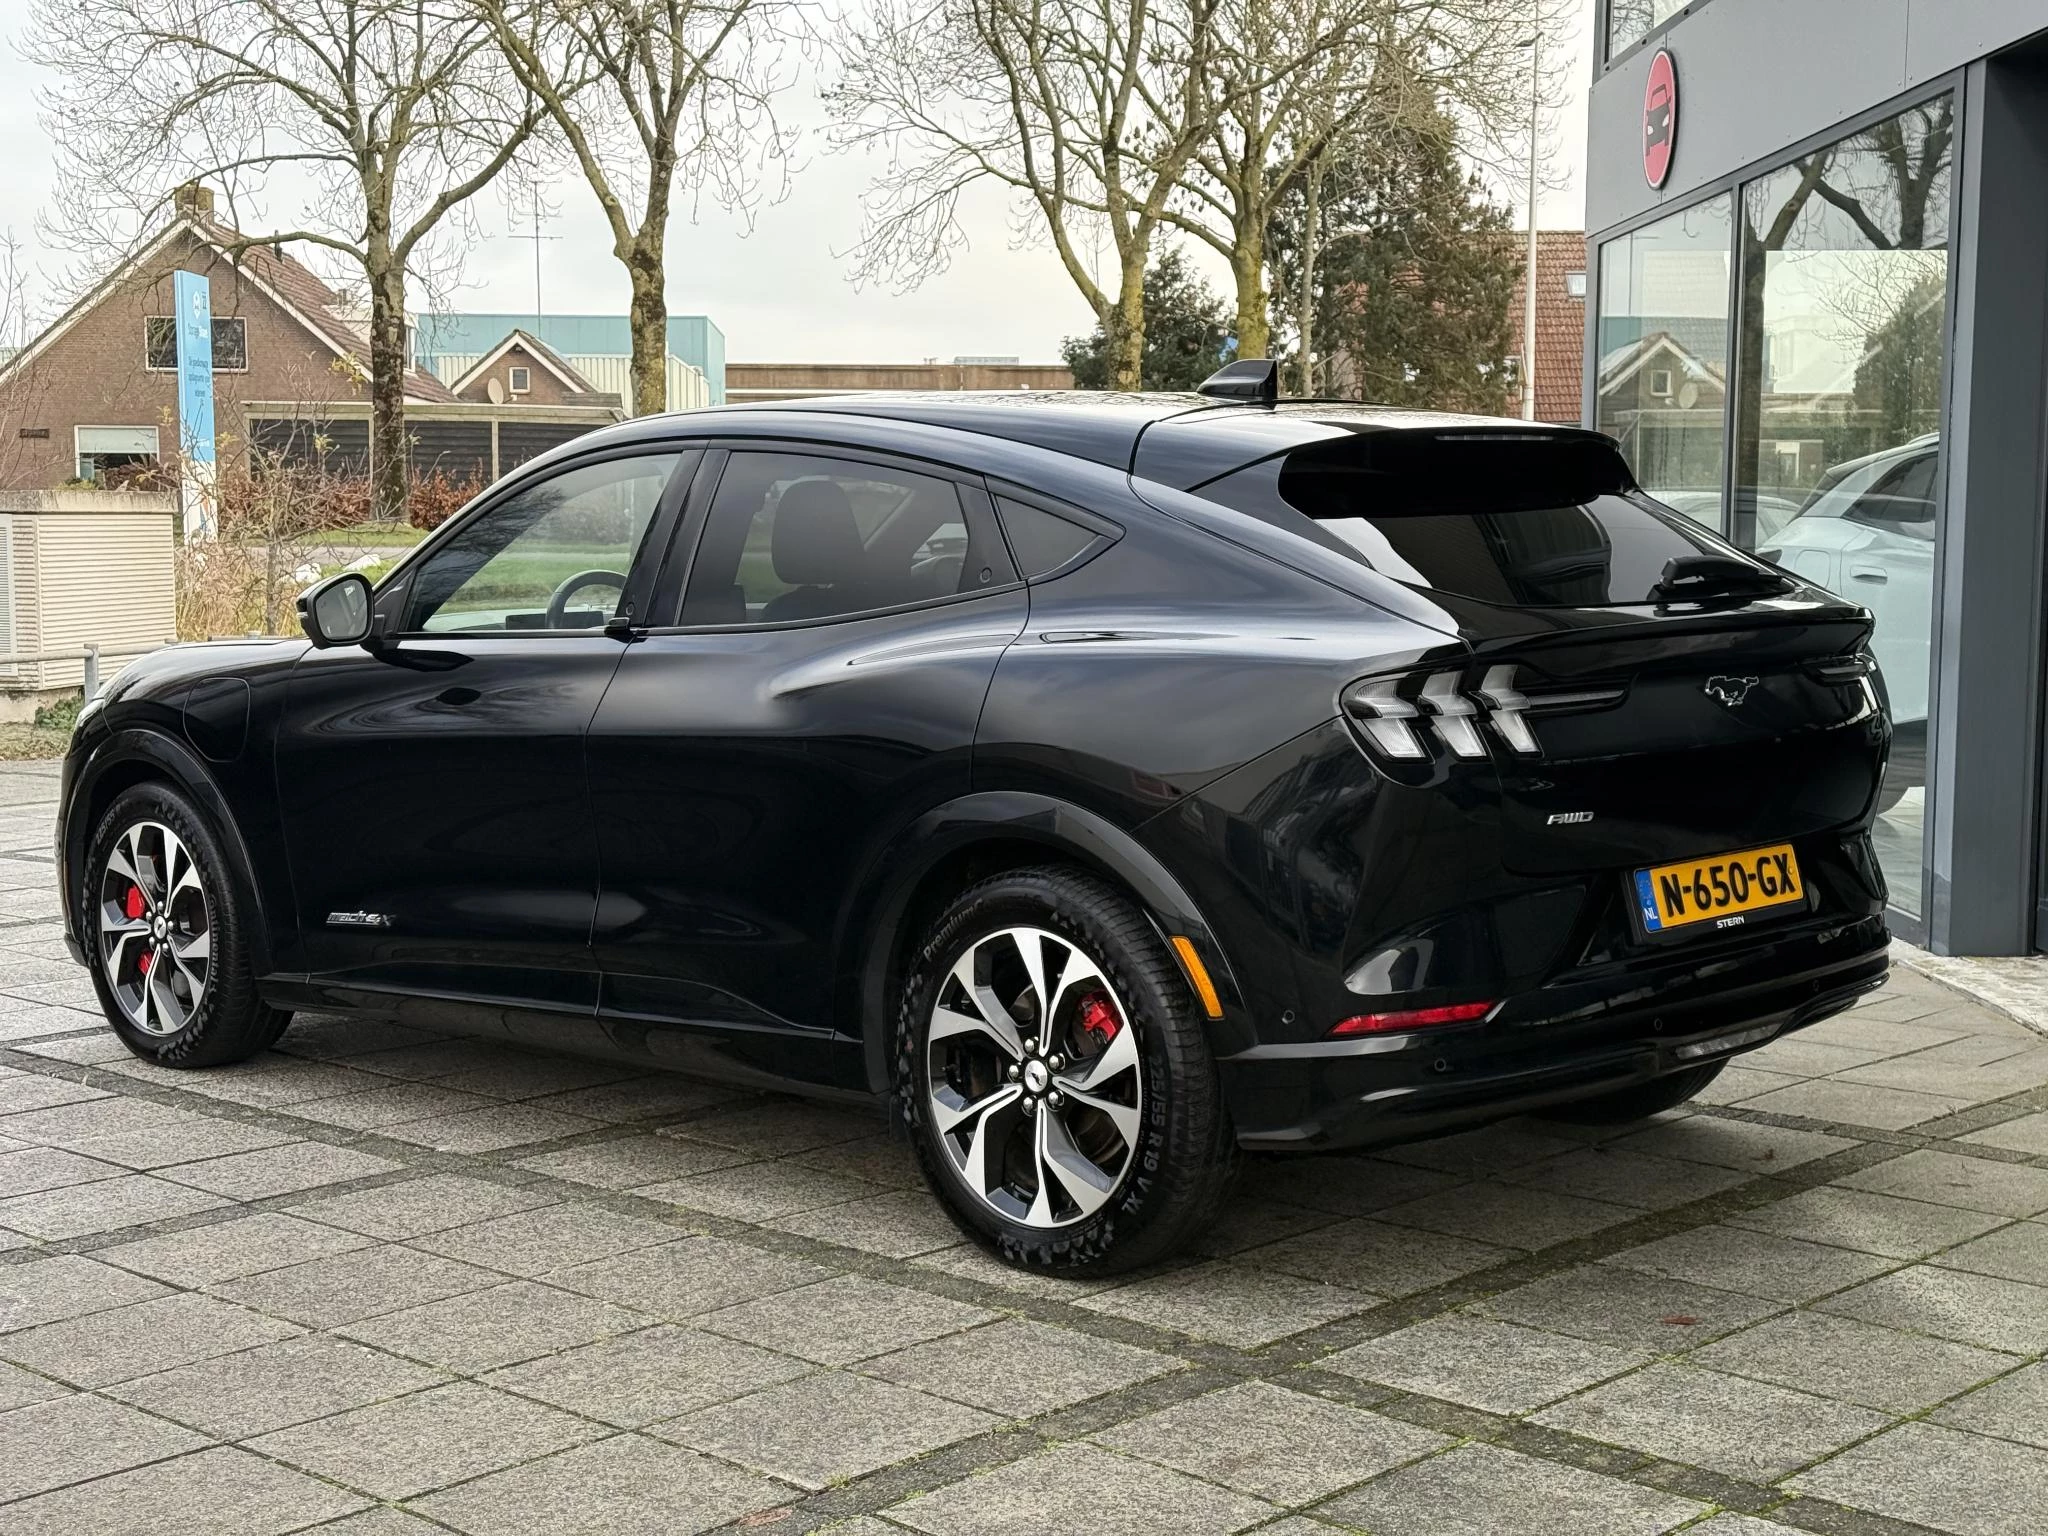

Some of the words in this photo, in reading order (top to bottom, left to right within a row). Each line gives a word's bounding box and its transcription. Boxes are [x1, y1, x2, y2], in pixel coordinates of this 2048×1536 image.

[1546, 811, 1594, 825] AWD
[1660, 853, 1796, 918] N-650-GX
[1643, 907, 1659, 921] NL
[1716, 915, 1745, 929] STERN
[1149, 1055, 1167, 1127] 225/55
